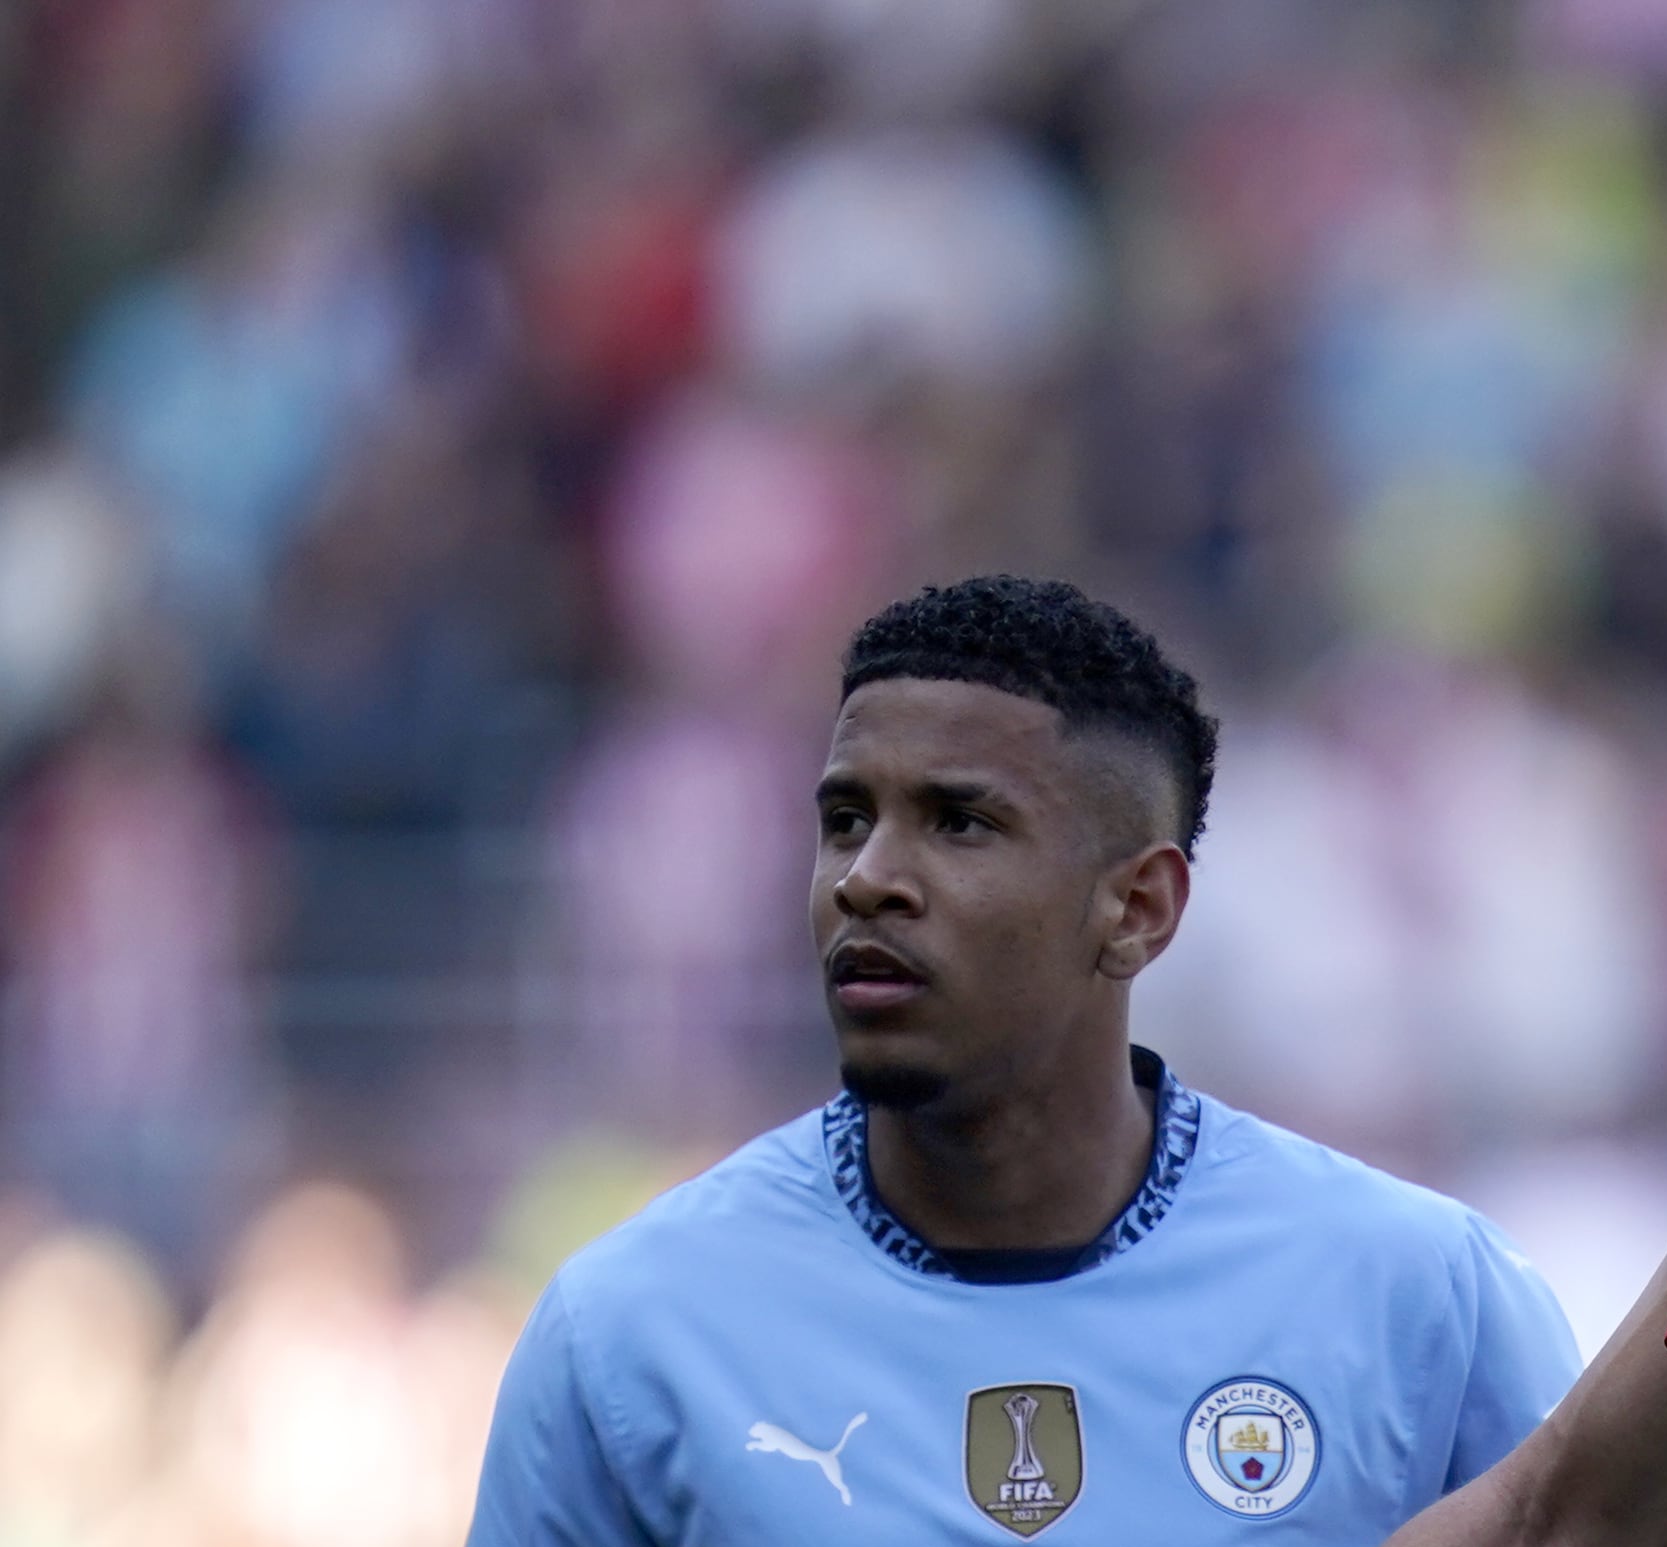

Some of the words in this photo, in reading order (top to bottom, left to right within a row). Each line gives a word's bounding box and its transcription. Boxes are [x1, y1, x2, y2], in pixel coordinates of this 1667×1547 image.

[1196, 1388, 1304, 1431] MANCHESTER
[1000, 1481, 1053, 1501] FIFA
[1235, 1496, 1273, 1509] CITY
